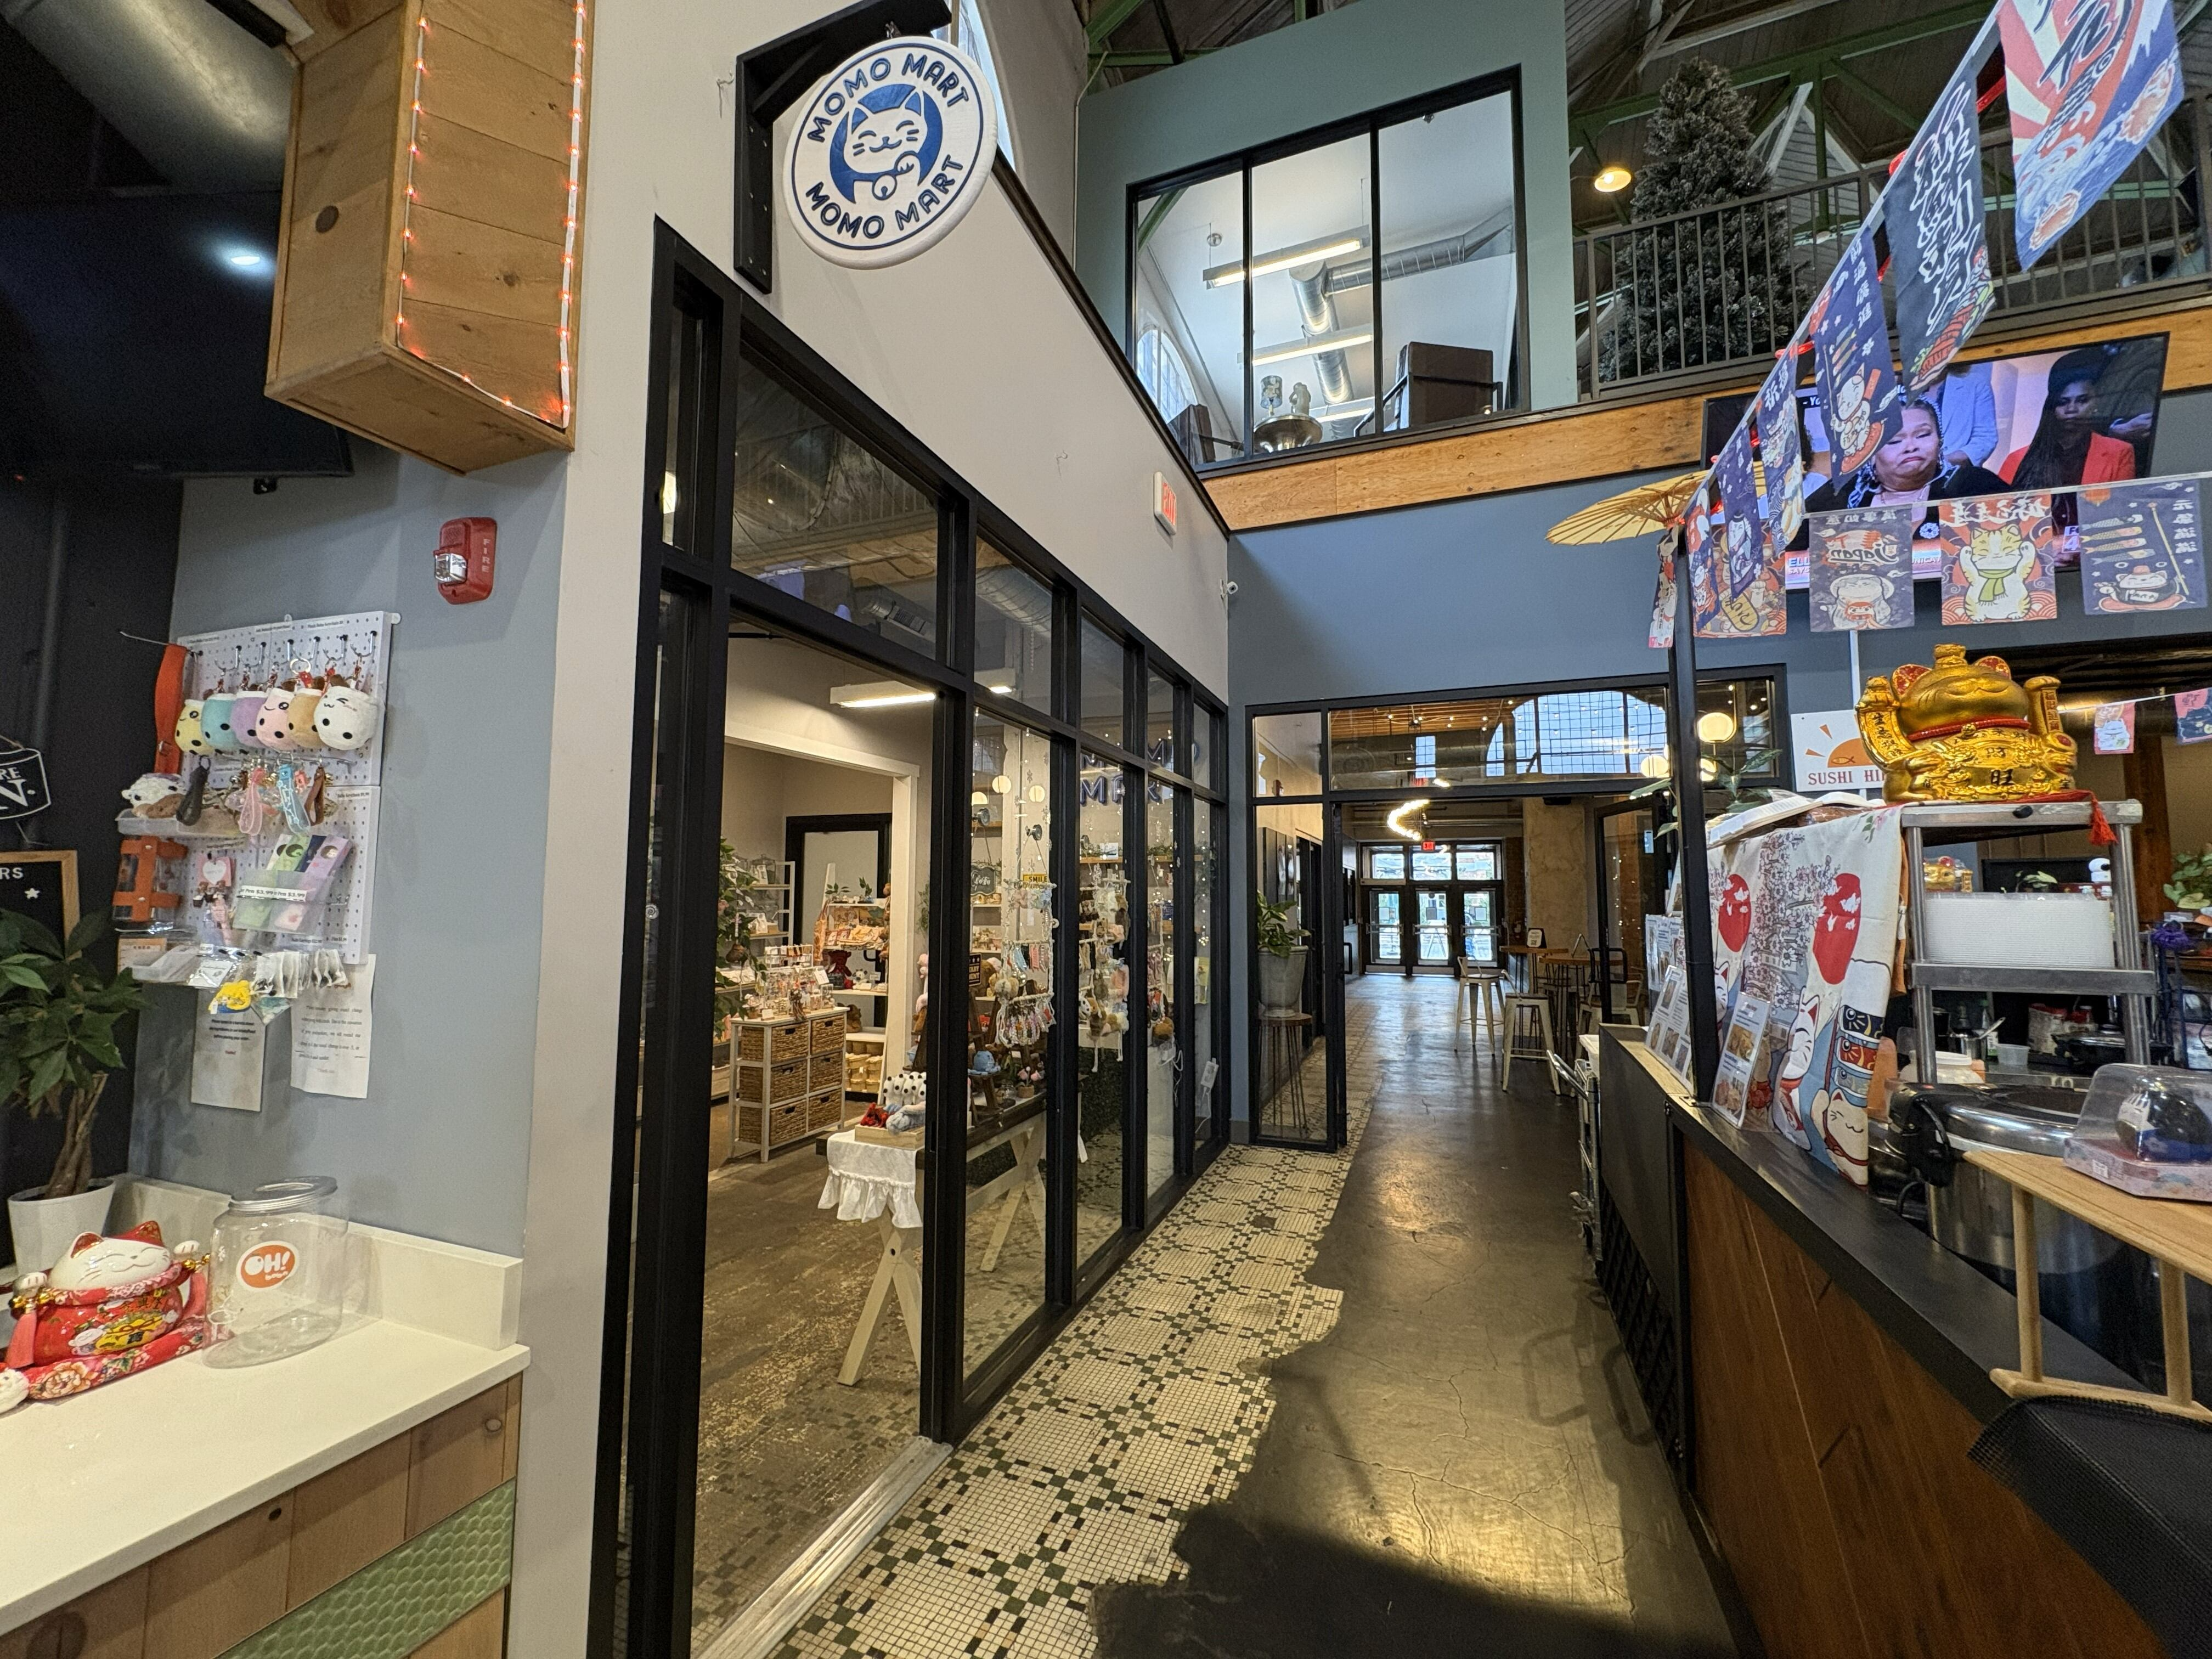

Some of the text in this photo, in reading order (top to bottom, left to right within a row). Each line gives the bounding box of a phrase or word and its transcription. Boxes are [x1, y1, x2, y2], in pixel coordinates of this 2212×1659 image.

[807, 53, 969, 143] MOMO MART
[805, 154, 963, 239] MOMO MART
[482, 538, 491, 573] FIRE
[1808, 770, 1853, 786] SUSHI
[1990, 769, 2015, 786] 旺
